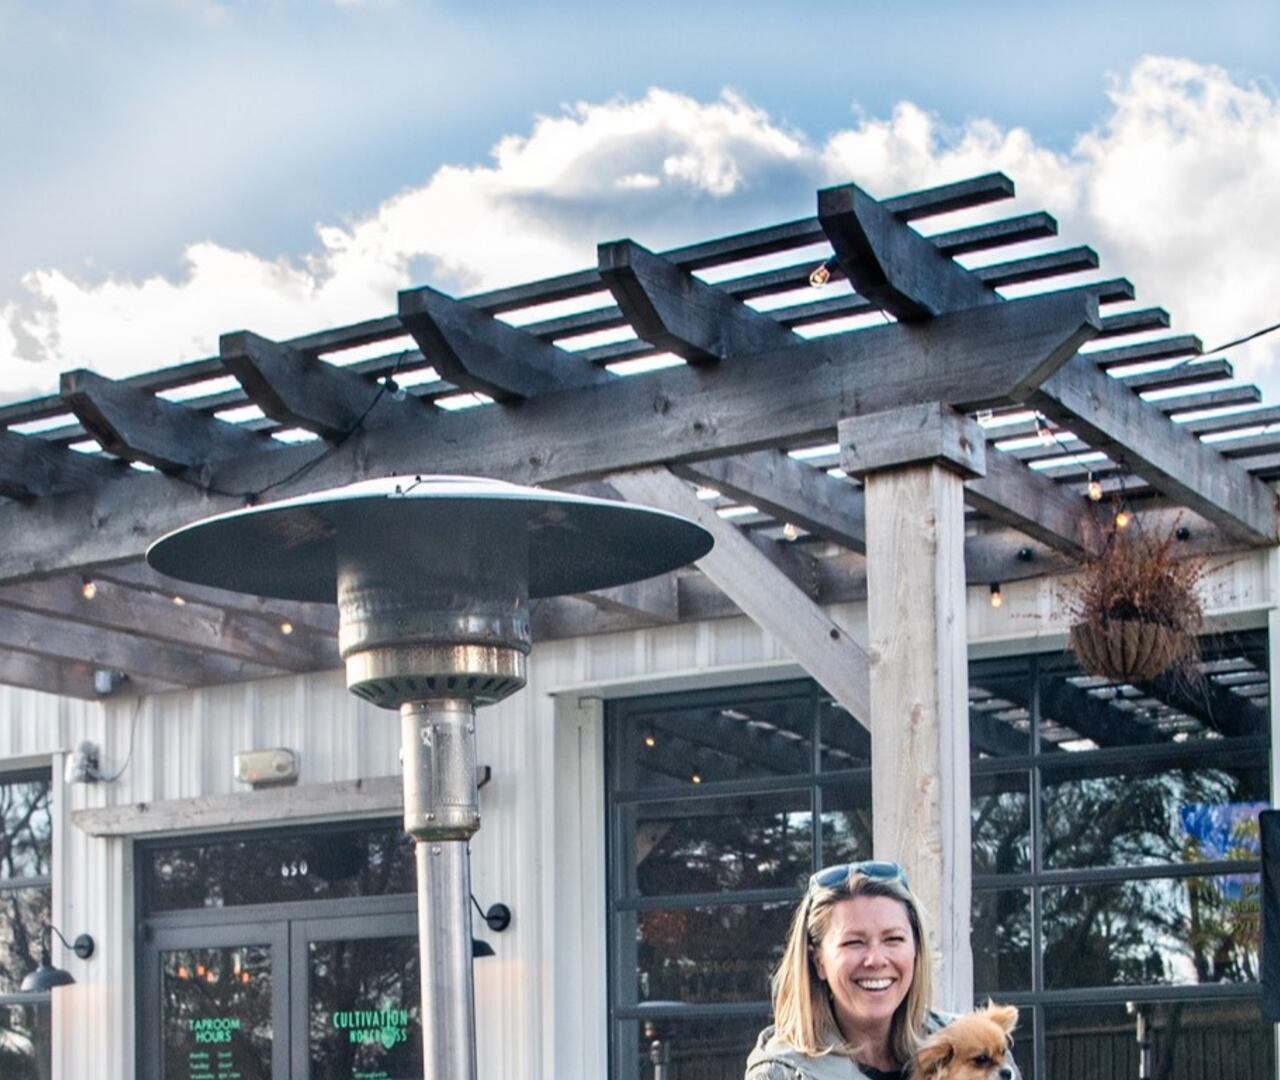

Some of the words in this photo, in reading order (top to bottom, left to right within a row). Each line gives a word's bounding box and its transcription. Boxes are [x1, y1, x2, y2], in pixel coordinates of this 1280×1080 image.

[281, 860, 308, 877] 650
[188, 1018, 241, 1031] TAPROOM
[333, 1009, 408, 1028] CULTIVATION
[195, 1030, 232, 1043] HOURS
